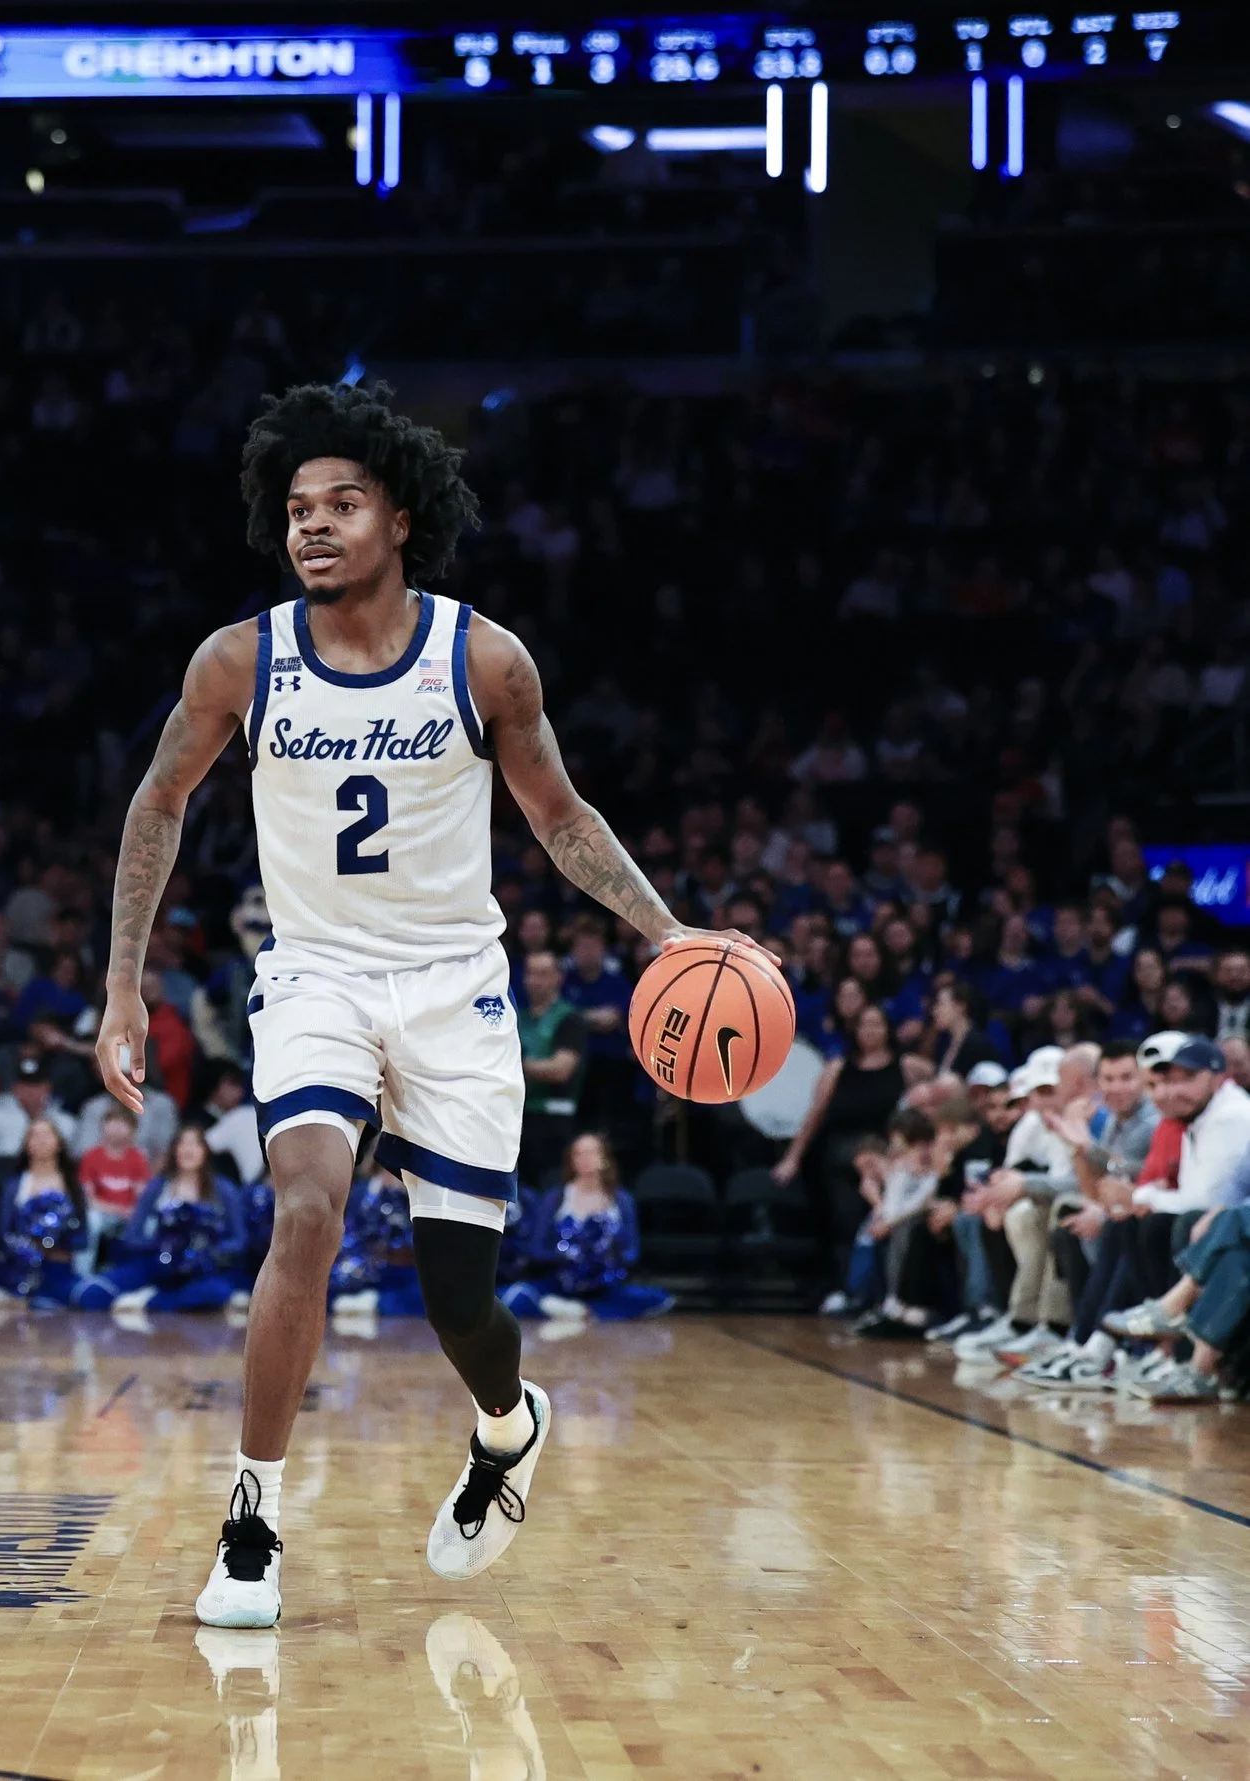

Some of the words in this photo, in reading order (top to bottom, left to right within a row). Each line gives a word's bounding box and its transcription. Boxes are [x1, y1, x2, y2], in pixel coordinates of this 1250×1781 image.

[62, 40, 355, 78] CREIGHTON
[270, 664, 303, 672] CHANGE
[287, 656, 301, 664] THE
[416, 685, 449, 693] EAST
[421, 678, 443, 686] BIG
[269, 718, 358, 760] Seton
[362, 718, 454, 761] Hall
[336, 774, 389, 875] 2
[656, 1005, 691, 1085] ELITE
